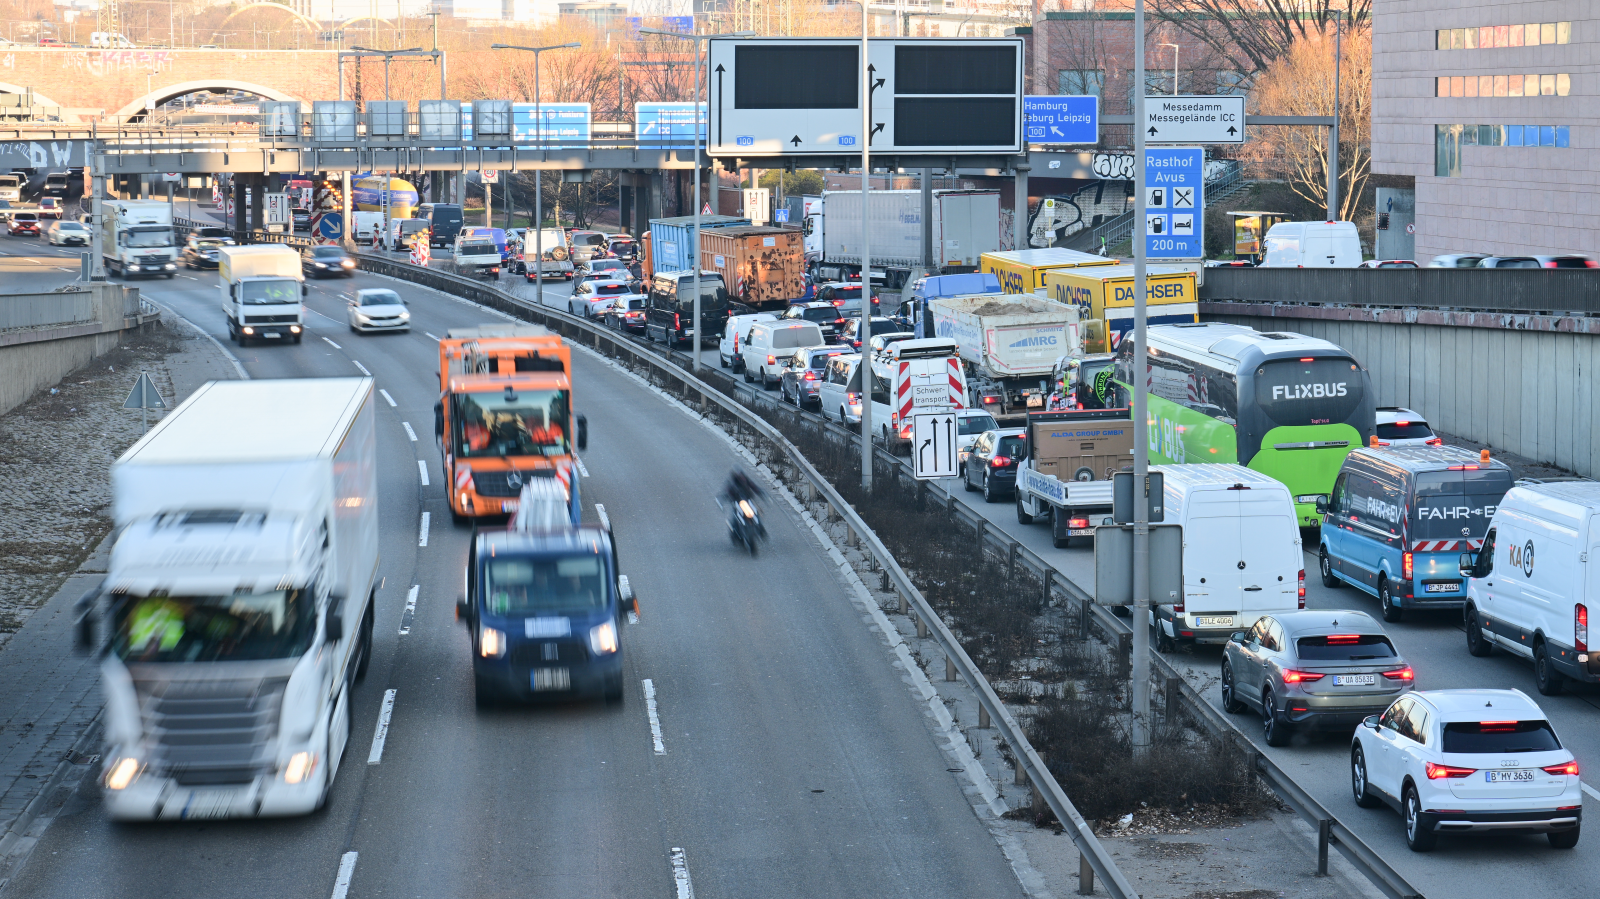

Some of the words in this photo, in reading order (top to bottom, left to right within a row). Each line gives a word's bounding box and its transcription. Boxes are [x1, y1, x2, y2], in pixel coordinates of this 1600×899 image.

[1024, 102, 1068, 112] Hamburg
[1162, 103, 1222, 112] Messedamm
[1058, 114, 1091, 124] Leipzig
[1150, 114, 1216, 124] Messegelände
[1220, 114, 1236, 122] ICC
[1030, 128, 1042, 136] 100
[738, 137, 752, 145] 100
[840, 136, 854, 144] 100
[1146, 156, 1193, 167] Rasthof
[1155, 172, 1186, 182] Avus
[1152, 240, 1174, 250] 200
[1176, 242, 1188, 250] m
[1114, 284, 1184, 301] DAHSER
[1028, 336, 1057, 346] MRG
[916, 396, 948, 404] transport
[1337, 676, 1342, 684] B
[1346, 676, 1354, 684] UA
[1514, 772, 1532, 780] 3636
